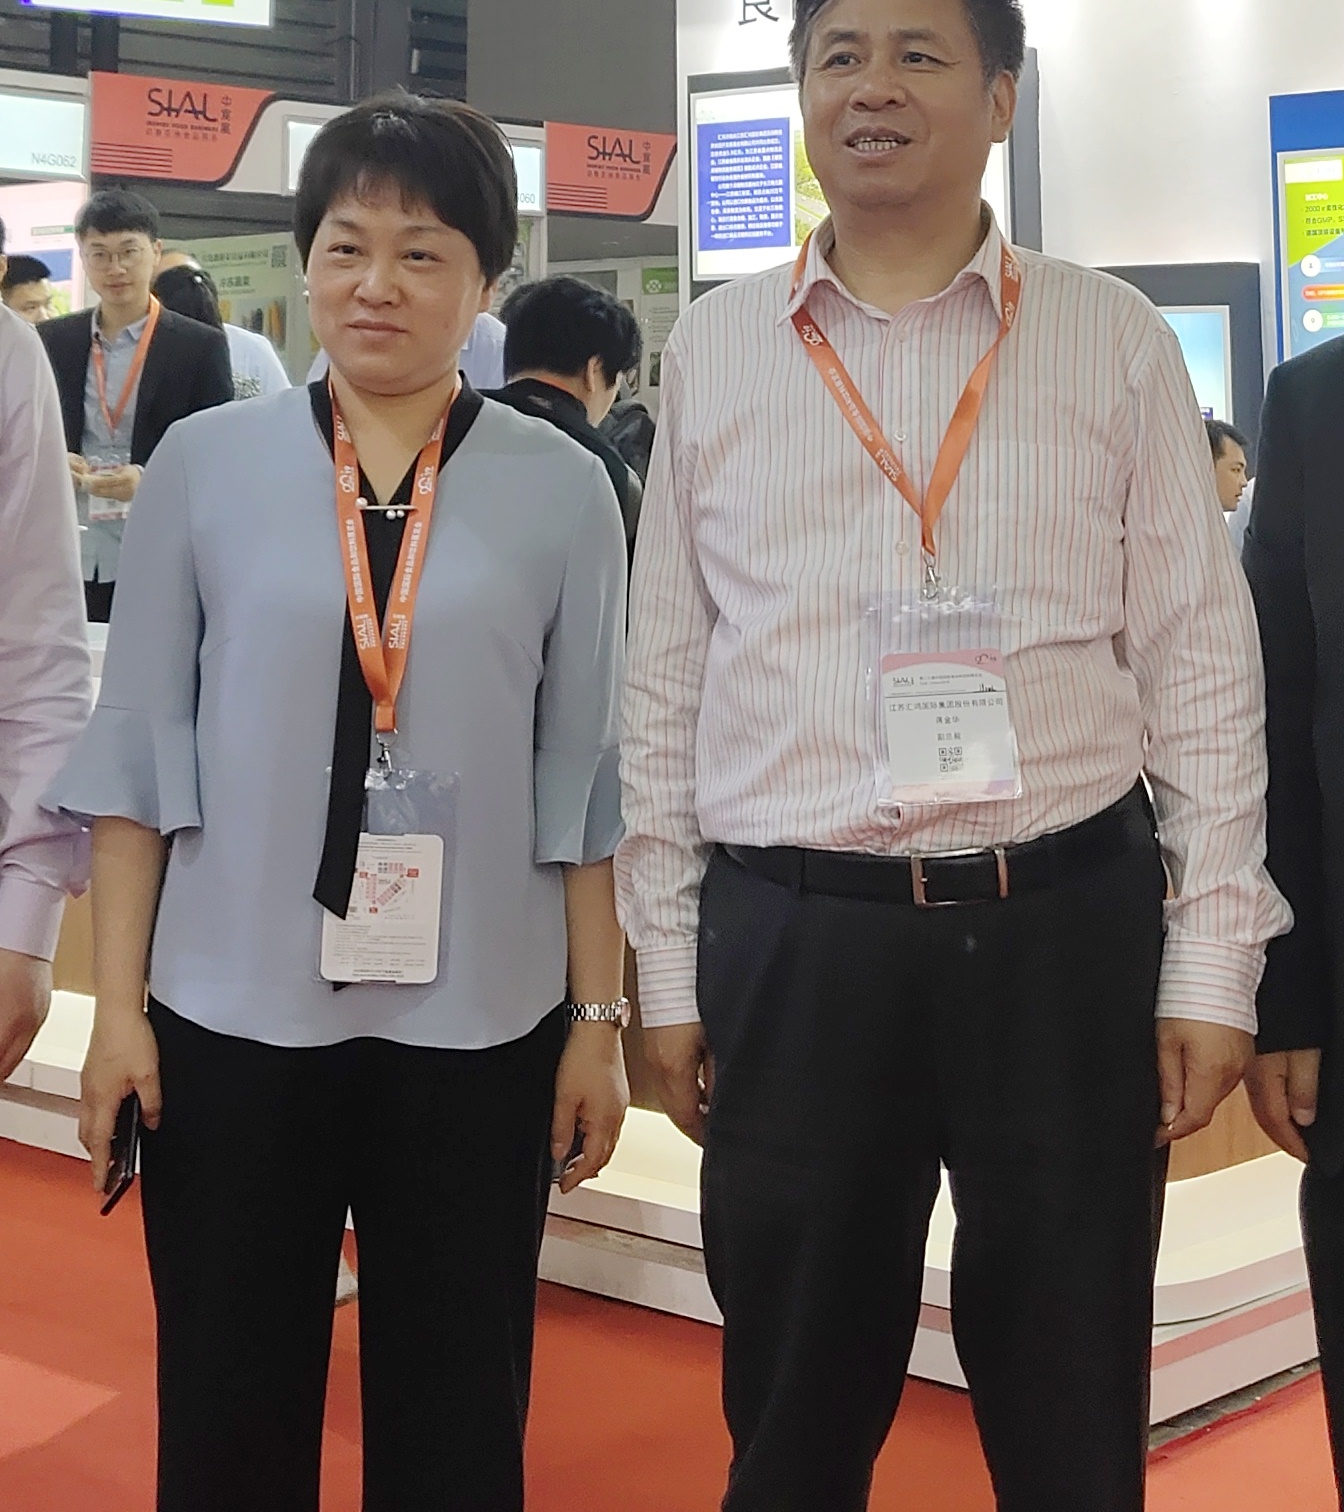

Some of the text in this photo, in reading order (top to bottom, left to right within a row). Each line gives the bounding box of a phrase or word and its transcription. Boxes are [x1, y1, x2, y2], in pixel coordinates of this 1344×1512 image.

[147, 87, 219, 123] SIAL
[31, 152, 77, 169] N4G062
[587, 134, 641, 165] SIAL
